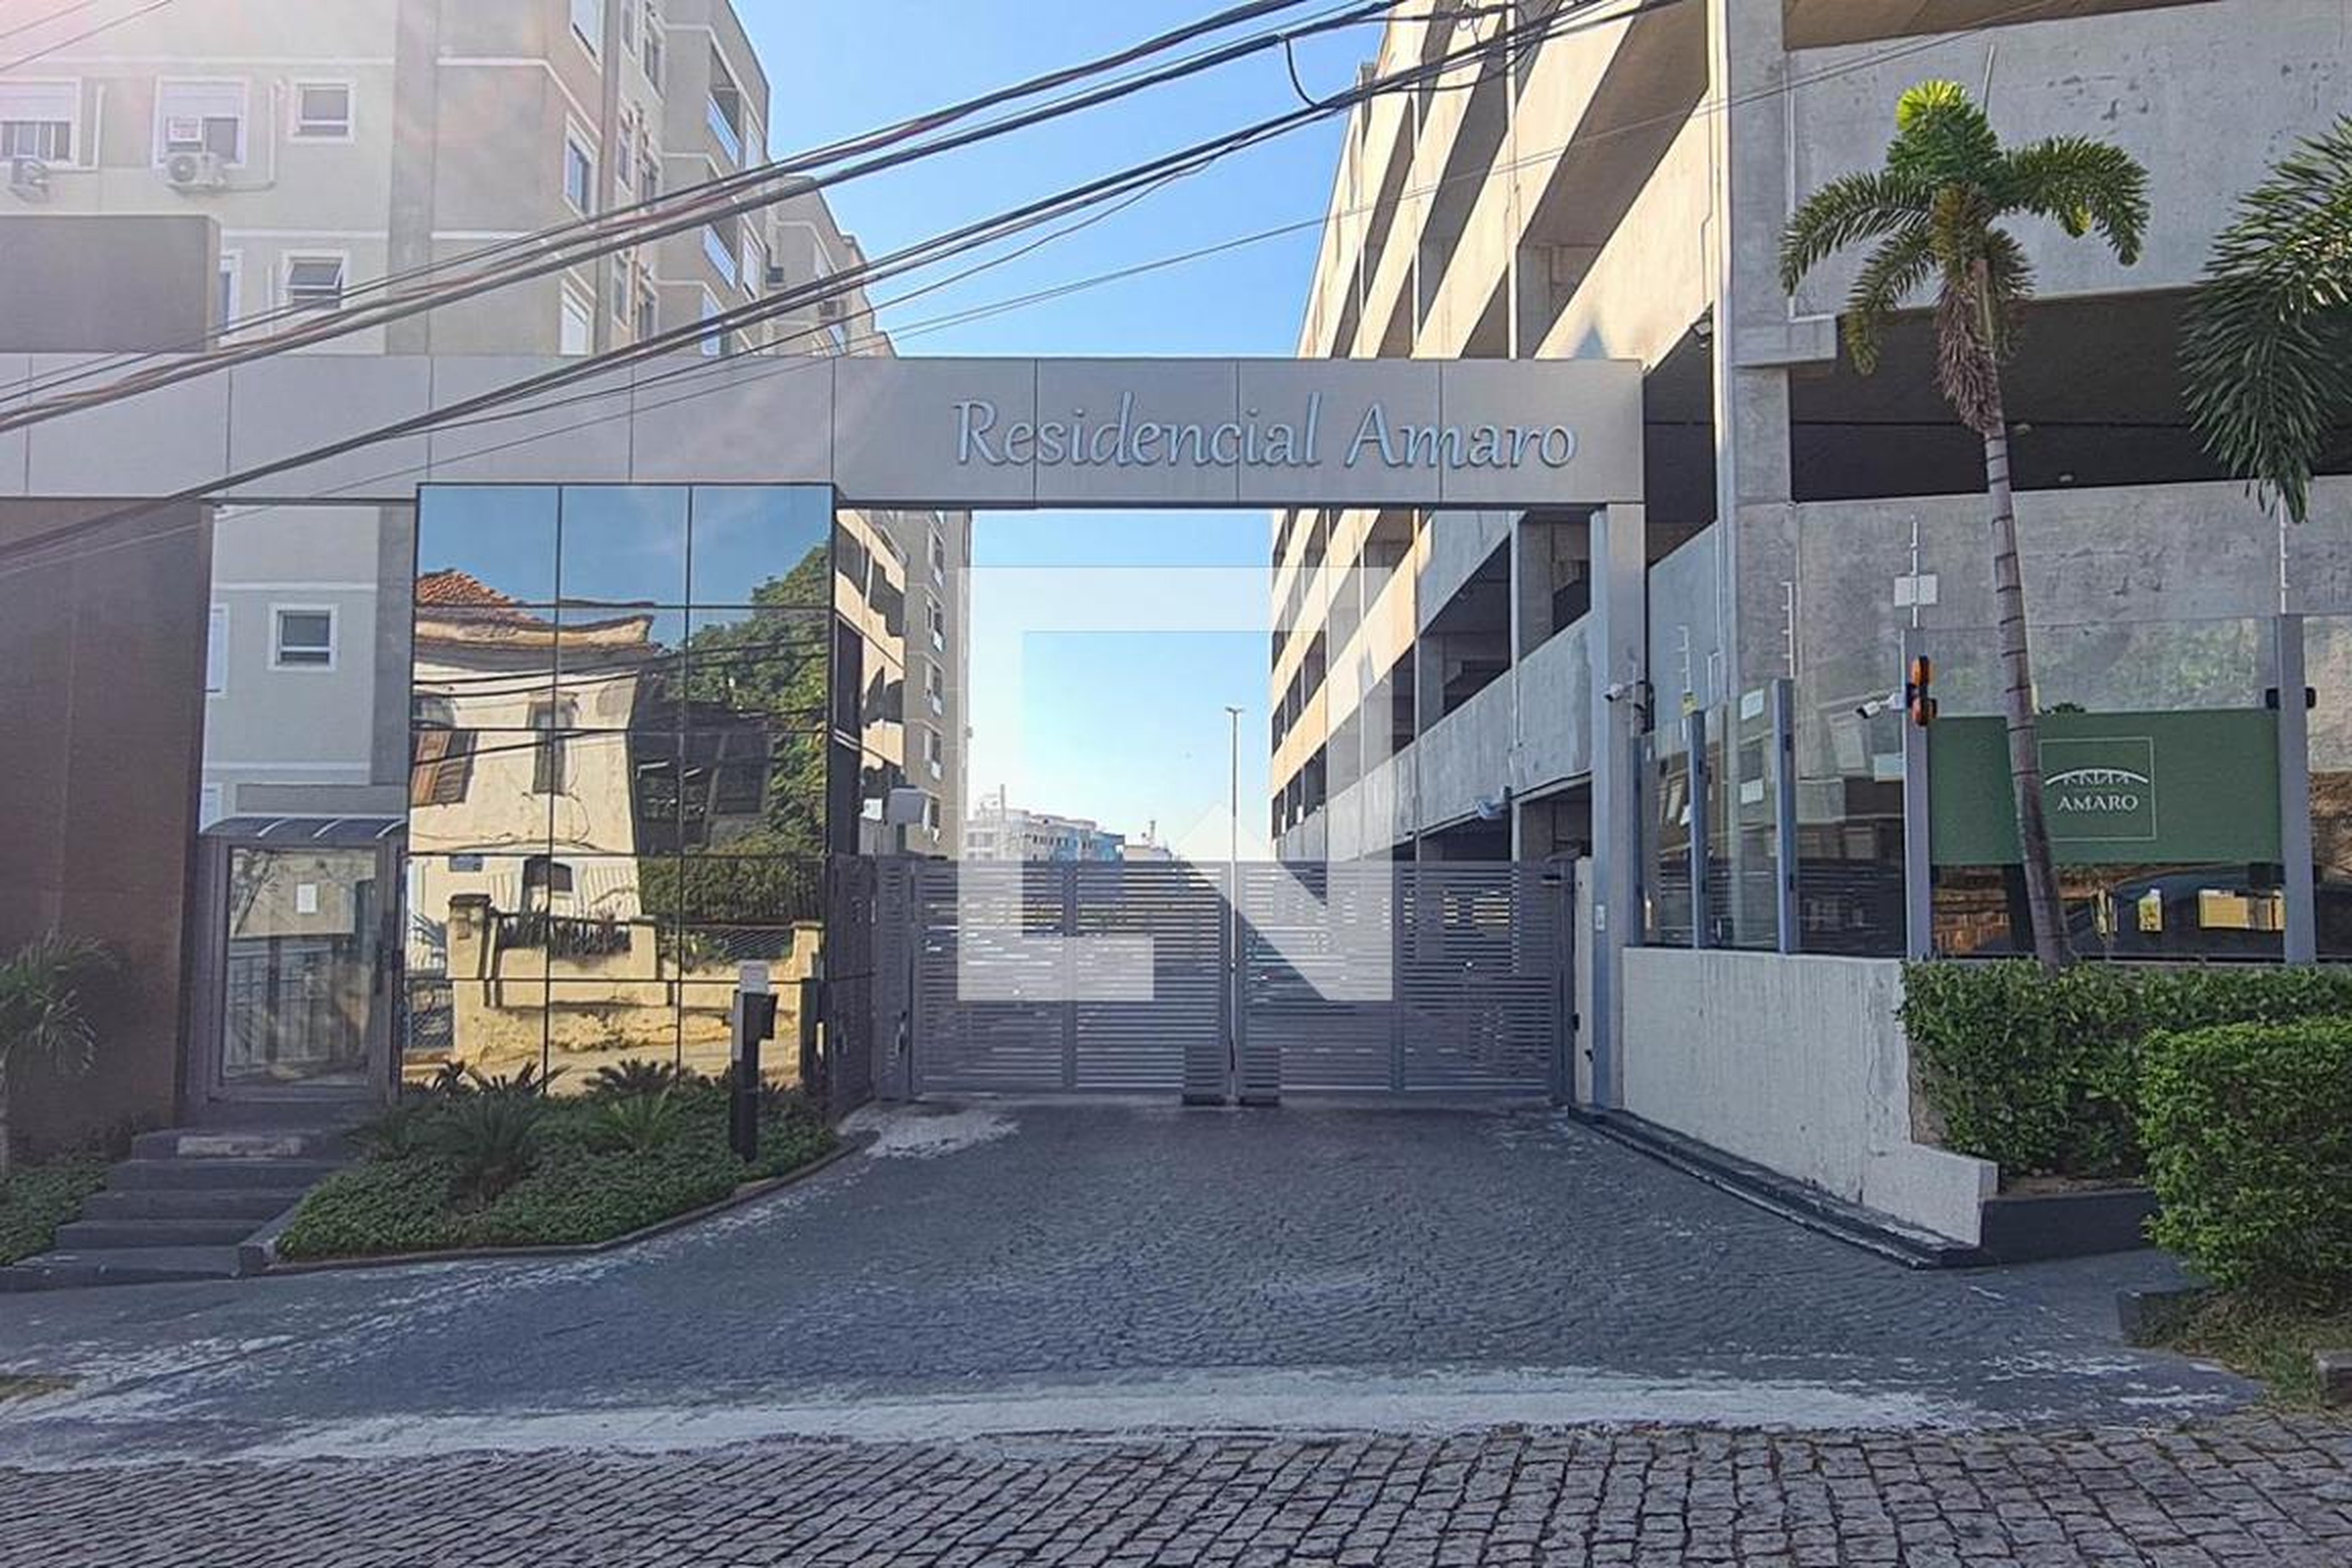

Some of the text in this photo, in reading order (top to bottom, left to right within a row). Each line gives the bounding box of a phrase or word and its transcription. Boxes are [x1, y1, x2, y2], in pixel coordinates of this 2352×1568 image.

[954, 391, 1578, 469] Residencial Amaro
[2057, 794, 2139, 812] AMARO
